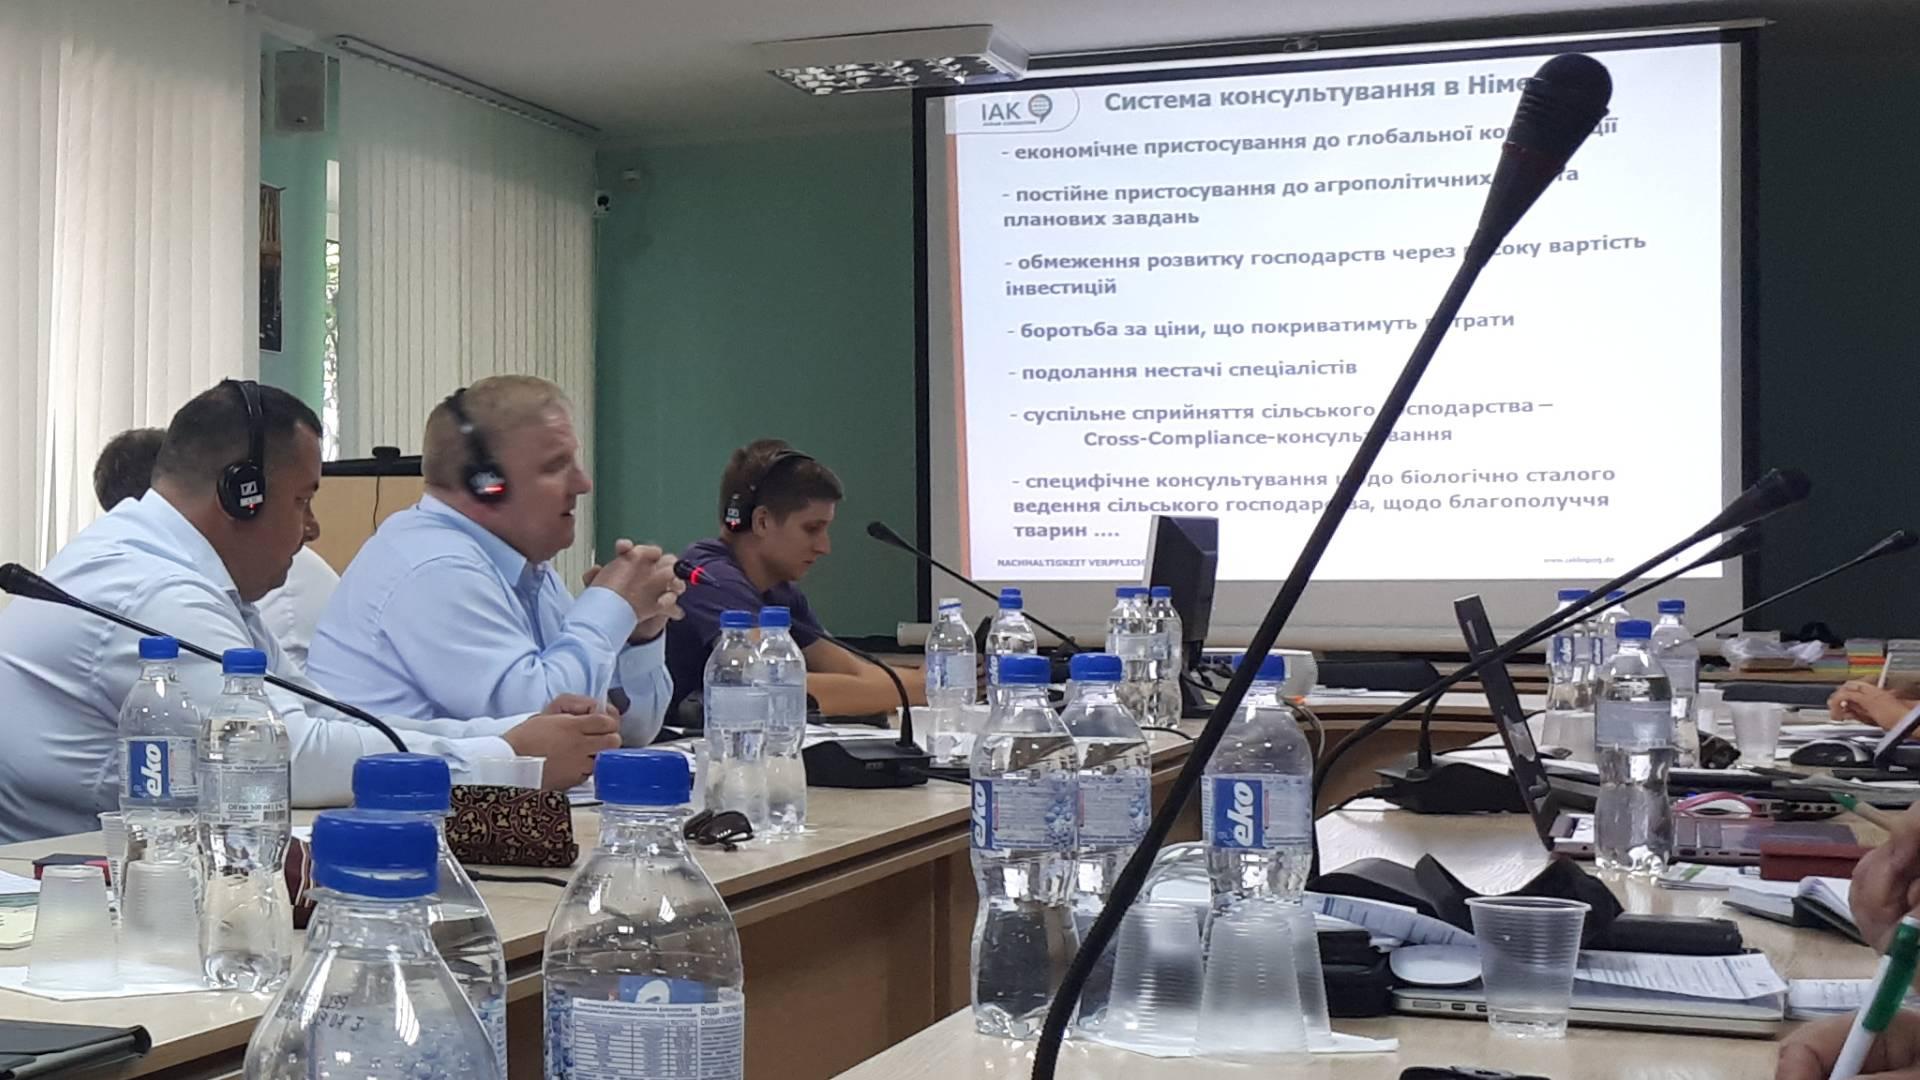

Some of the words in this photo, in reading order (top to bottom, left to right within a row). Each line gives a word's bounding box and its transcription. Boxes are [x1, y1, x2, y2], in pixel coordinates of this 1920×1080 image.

[1104, 92, 1211, 112] Система
[1219, 81, 1436, 109] консультування
[1444, 80, 1460, 95] в
[1468, 74, 1529, 95] Німе
[982, 102, 1021, 121] IAK
[1014, 141, 1138, 160] економічне
[1144, 135, 1306, 158] пристосування
[1312, 134, 1340, 151] до
[1346, 125, 1473, 147] глобальної
[1016, 185, 1109, 203] постійне
[1114, 179, 1276, 204] пристосування
[1282, 180, 1308, 197] до
[1314, 173, 1492, 196] агрополітичних
[1003, 214, 1106, 228] планових
[1111, 212, 1200, 228] завдань
[1017, 254, 1141, 270] обмеження
[1147, 252, 1245, 272] розвитку
[1250, 249, 1386, 267] господарств
[1392, 246, 1456, 263] через
[1549, 234, 1647, 253] вартість
[1005, 278, 1117, 297] інвестицій
[1020, 322, 1118, 341] боротьба
[1123, 324, 1148, 337] за
[1154, 320, 1207, 339] ціни,
[1213, 322, 1245, 338] що
[1251, 318, 1418, 339] покриватимуть
[1022, 365, 1138, 383] подолання
[1144, 362, 1222, 378] нестачі
[1228, 359, 1358, 378] спеціалістів
[1023, 406, 1126, 425] суспільне
[1131, 404, 1255, 424] сприйняття
[1261, 402, 1377, 420] сільського
[1402, 400, 1534, 418] сподарства
[1083, 428, 1453, 449] Cross-Compliance-консульвання
[1025, 473, 1150, 492] специфічне
[1156, 473, 1328, 492] консультування
[1400, 468, 1519, 485] біологічно
[1525, 469, 1616, 483] сталого
[1013, 501, 1101, 516] ведення
[1106, 497, 1219, 513] сільського
[1383, 497, 1442, 512] щодо
[1448, 493, 1609, 512] благополуччя
[1013, 525, 1088, 541] тварин
[141, 743, 162, 797] eko
[971, 781, 986, 848] eko
[1226, 781, 1254, 847] eko
